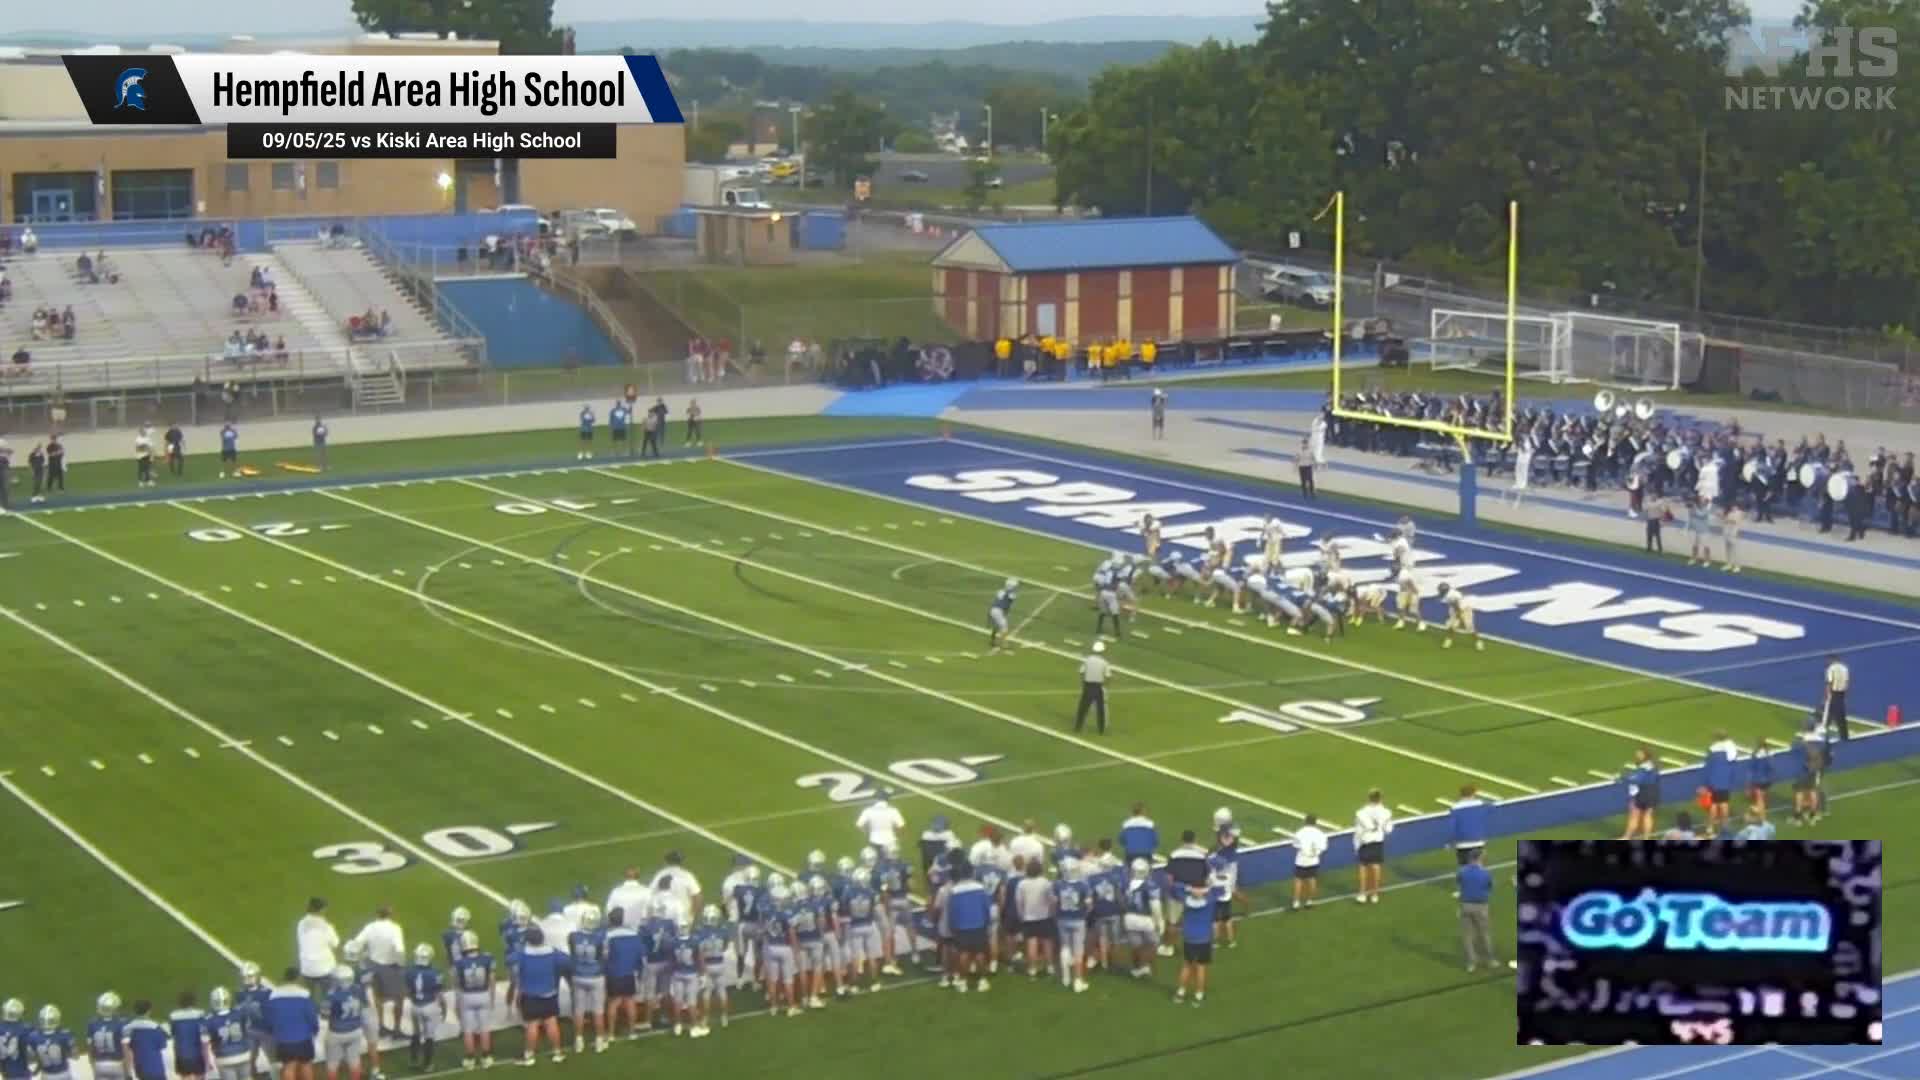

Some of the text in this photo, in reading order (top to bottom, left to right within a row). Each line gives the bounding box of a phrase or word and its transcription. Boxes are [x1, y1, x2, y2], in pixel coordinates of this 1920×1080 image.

[904, 468, 1806, 652] SPARTANS
[1217, 701, 1366, 733] 10
[795, 758, 978, 801] 20
[312, 825, 514, 875] 30
